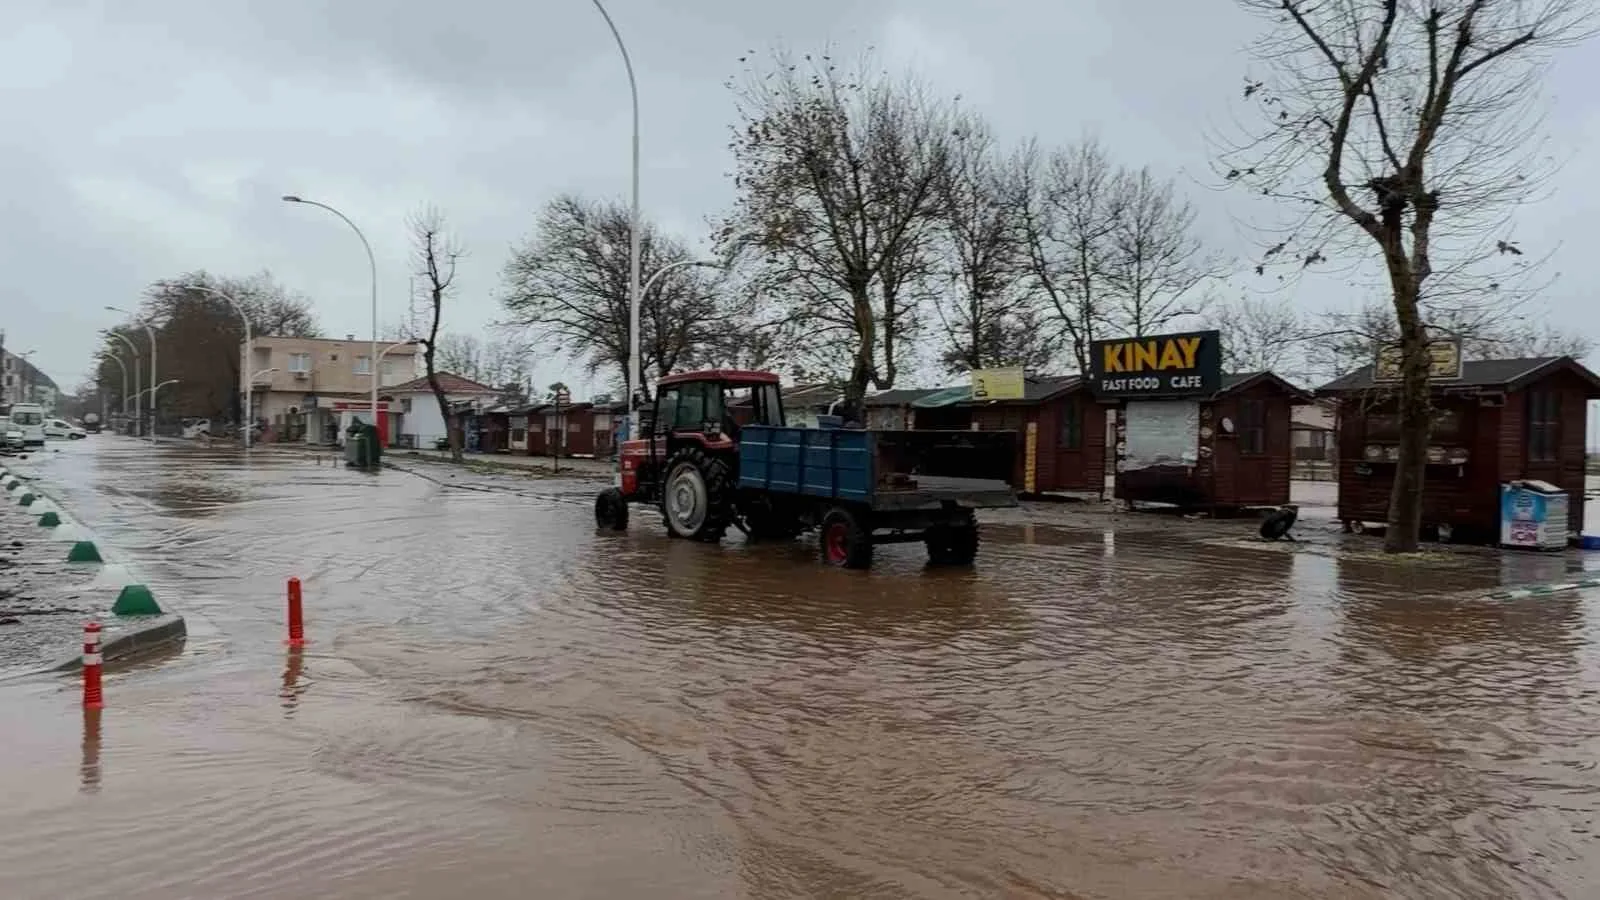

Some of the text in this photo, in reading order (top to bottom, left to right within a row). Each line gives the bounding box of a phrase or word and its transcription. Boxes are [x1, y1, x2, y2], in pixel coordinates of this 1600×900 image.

[1104, 338, 1200, 372] KINAY
[1102, 375, 1202, 391] FAST FOOD CAFE
